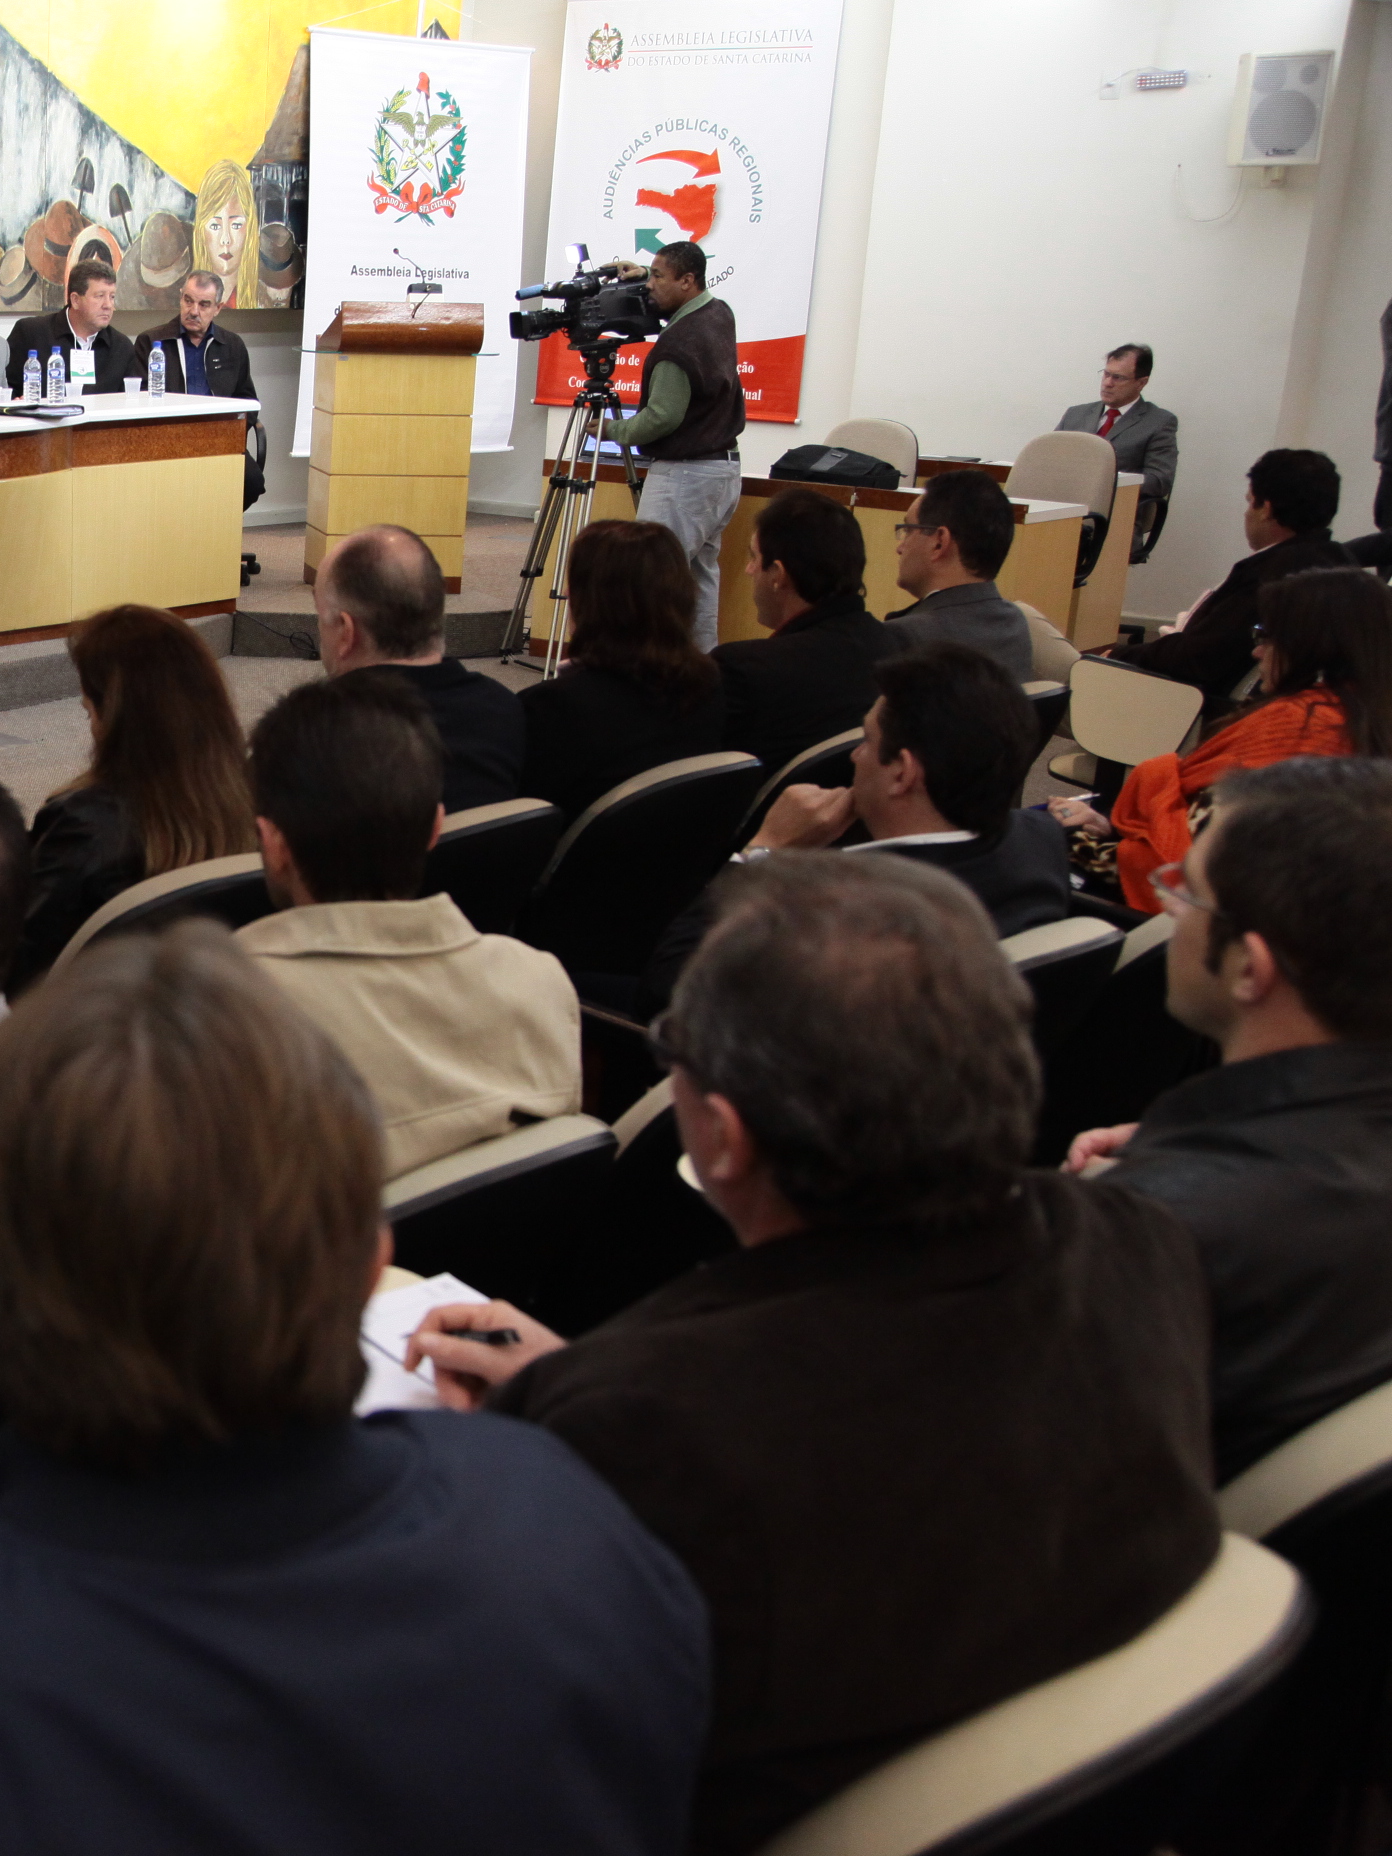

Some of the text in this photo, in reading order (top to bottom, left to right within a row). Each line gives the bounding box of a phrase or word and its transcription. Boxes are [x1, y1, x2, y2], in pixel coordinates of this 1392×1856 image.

[630, 28, 814, 47] ASSEMBLEIA LEGISLATIVA
[627, 52, 813, 67] DO ESTADO DE SANTA CATARINA
[603, 117, 763, 224] AUDIÊNCIAS PÚBLICAS REGIONAIS
[350, 264, 470, 281] Assembleia Legislativa
[628, 354, 640, 366] de
